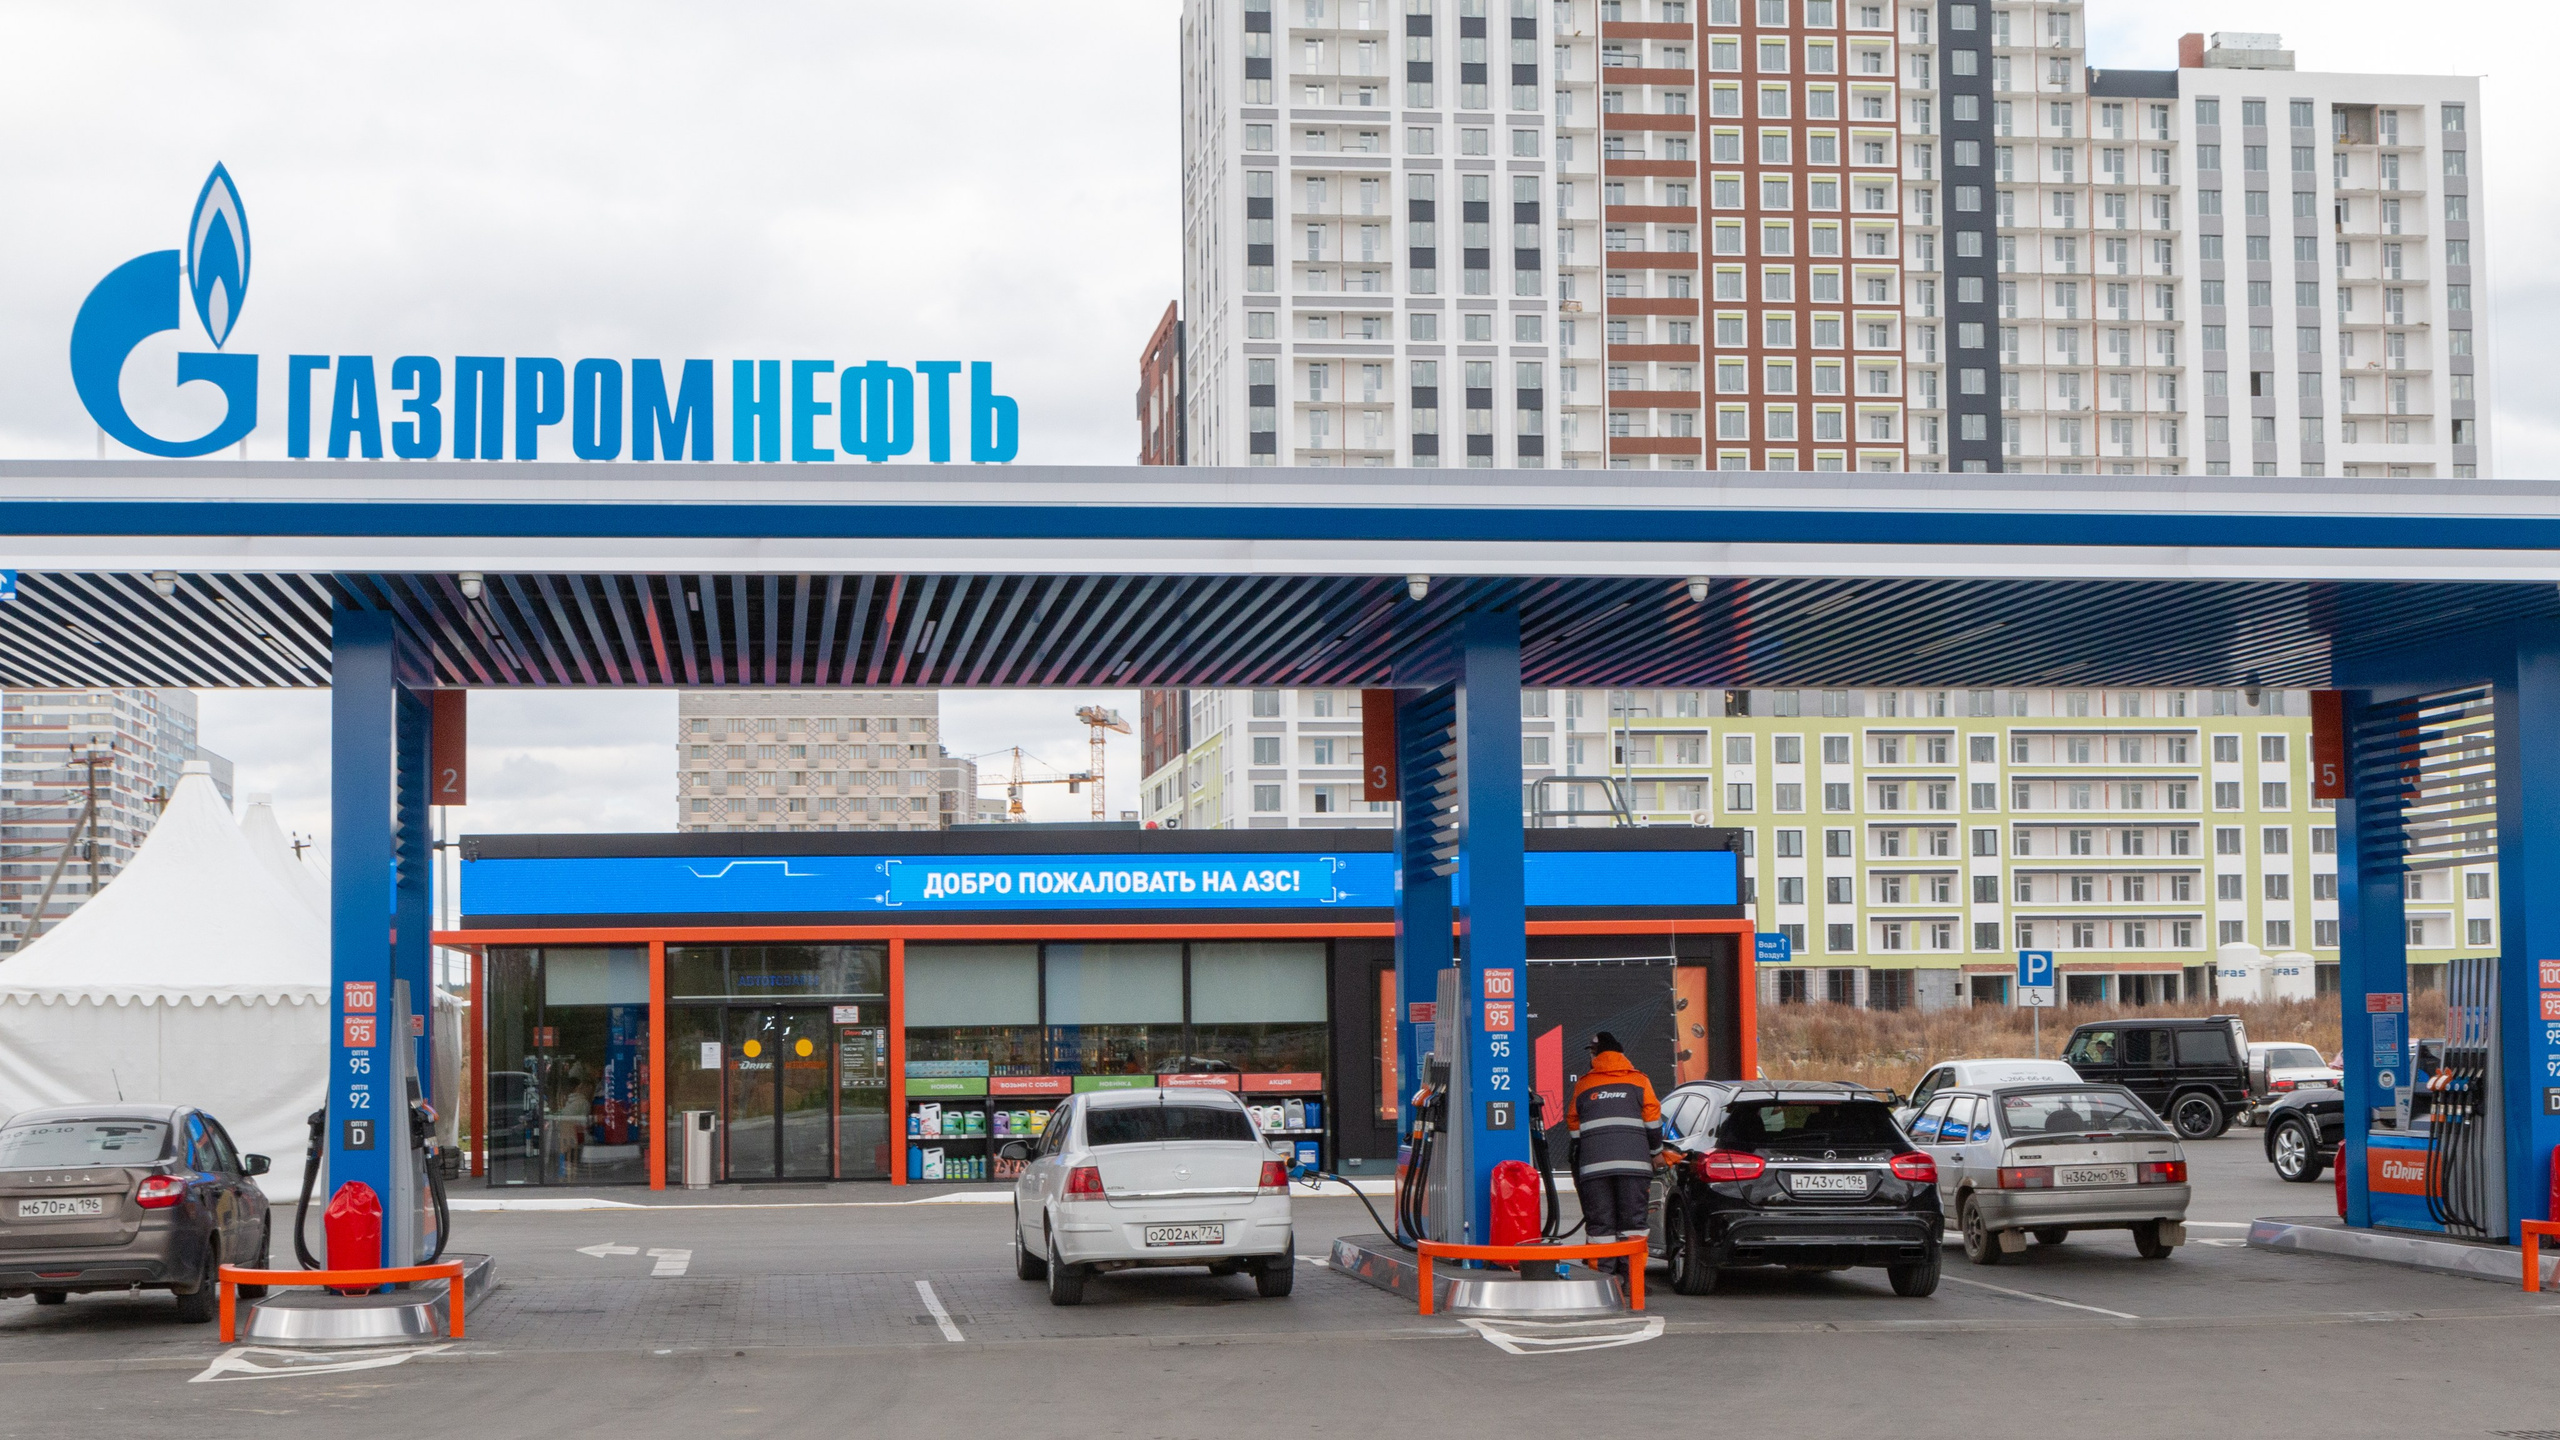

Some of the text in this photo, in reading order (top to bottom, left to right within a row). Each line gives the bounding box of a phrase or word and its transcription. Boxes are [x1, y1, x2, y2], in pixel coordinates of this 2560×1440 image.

[287, 353, 1020, 464] ГАЗПРОМ НЕФТЬ
[442, 768, 458, 793] 2
[1372, 765, 1388, 789] 3
[2322, 763, 2337, 786] 5
[923, 869, 1301, 899] ДОБРО ПОЖАЛОВАТЬ НА АЗС!
[1758, 940, 1777, 949] Вода
[1758, 951, 1785, 960] Воздух
[2027, 953, 2048, 983] P
[1485, 977, 1512, 994] 100
[345, 991, 374, 1008] 100
[1489, 1010, 1509, 1026] 95
[349, 1025, 371, 1042] 95
[1490, 1041, 1510, 1058] 95
[349, 1057, 371, 1075] 95
[1034, 1080, 1059, 1088] СОБОЙ
[1490, 1074, 1511, 1091] 92
[349, 1092, 371, 1109] 92
[1494, 1109, 1507, 1126] D
[352, 1128, 366, 1145] D
[28, 1174, 91, 1183] LADA
[1795, 1175, 1864, 1189] Н743УС 196
[2066, 1170, 2126, 1183] Н362МО 196
[22, 1199, 100, 1215] М670РА 196
[1150, 1226, 1221, 1241] О202АК 774
